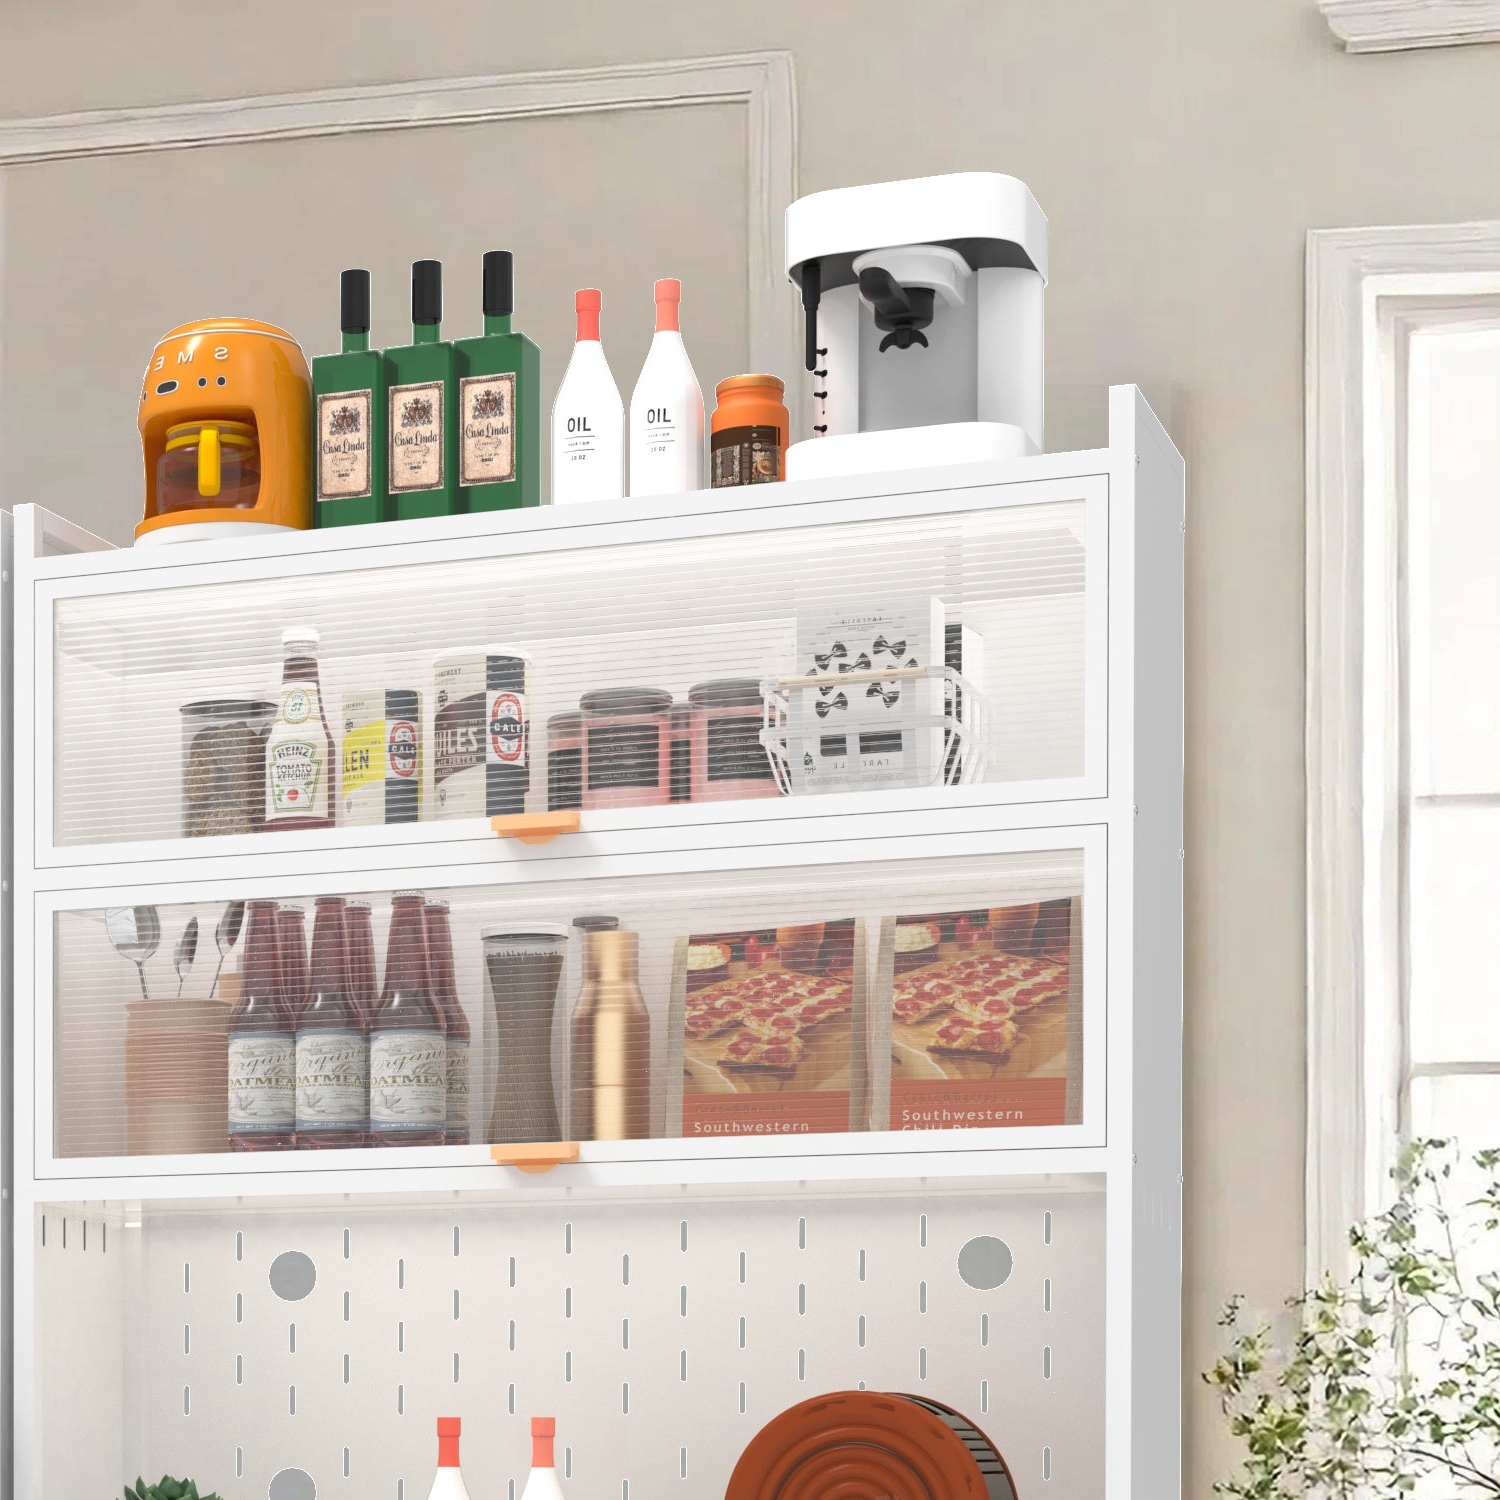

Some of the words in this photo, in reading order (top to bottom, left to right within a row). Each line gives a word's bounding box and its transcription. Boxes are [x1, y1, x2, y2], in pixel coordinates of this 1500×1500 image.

[647, 408, 672, 424] OIL
[567, 417, 592, 433] OIL
[494, 723, 521, 733] CALE
[277, 746, 310, 758] HEINZ
[276, 764, 312, 774] TOMATO
[902, 1108, 1023, 1121] Southwestern
[694, 1121, 809, 1133] Southwestern
